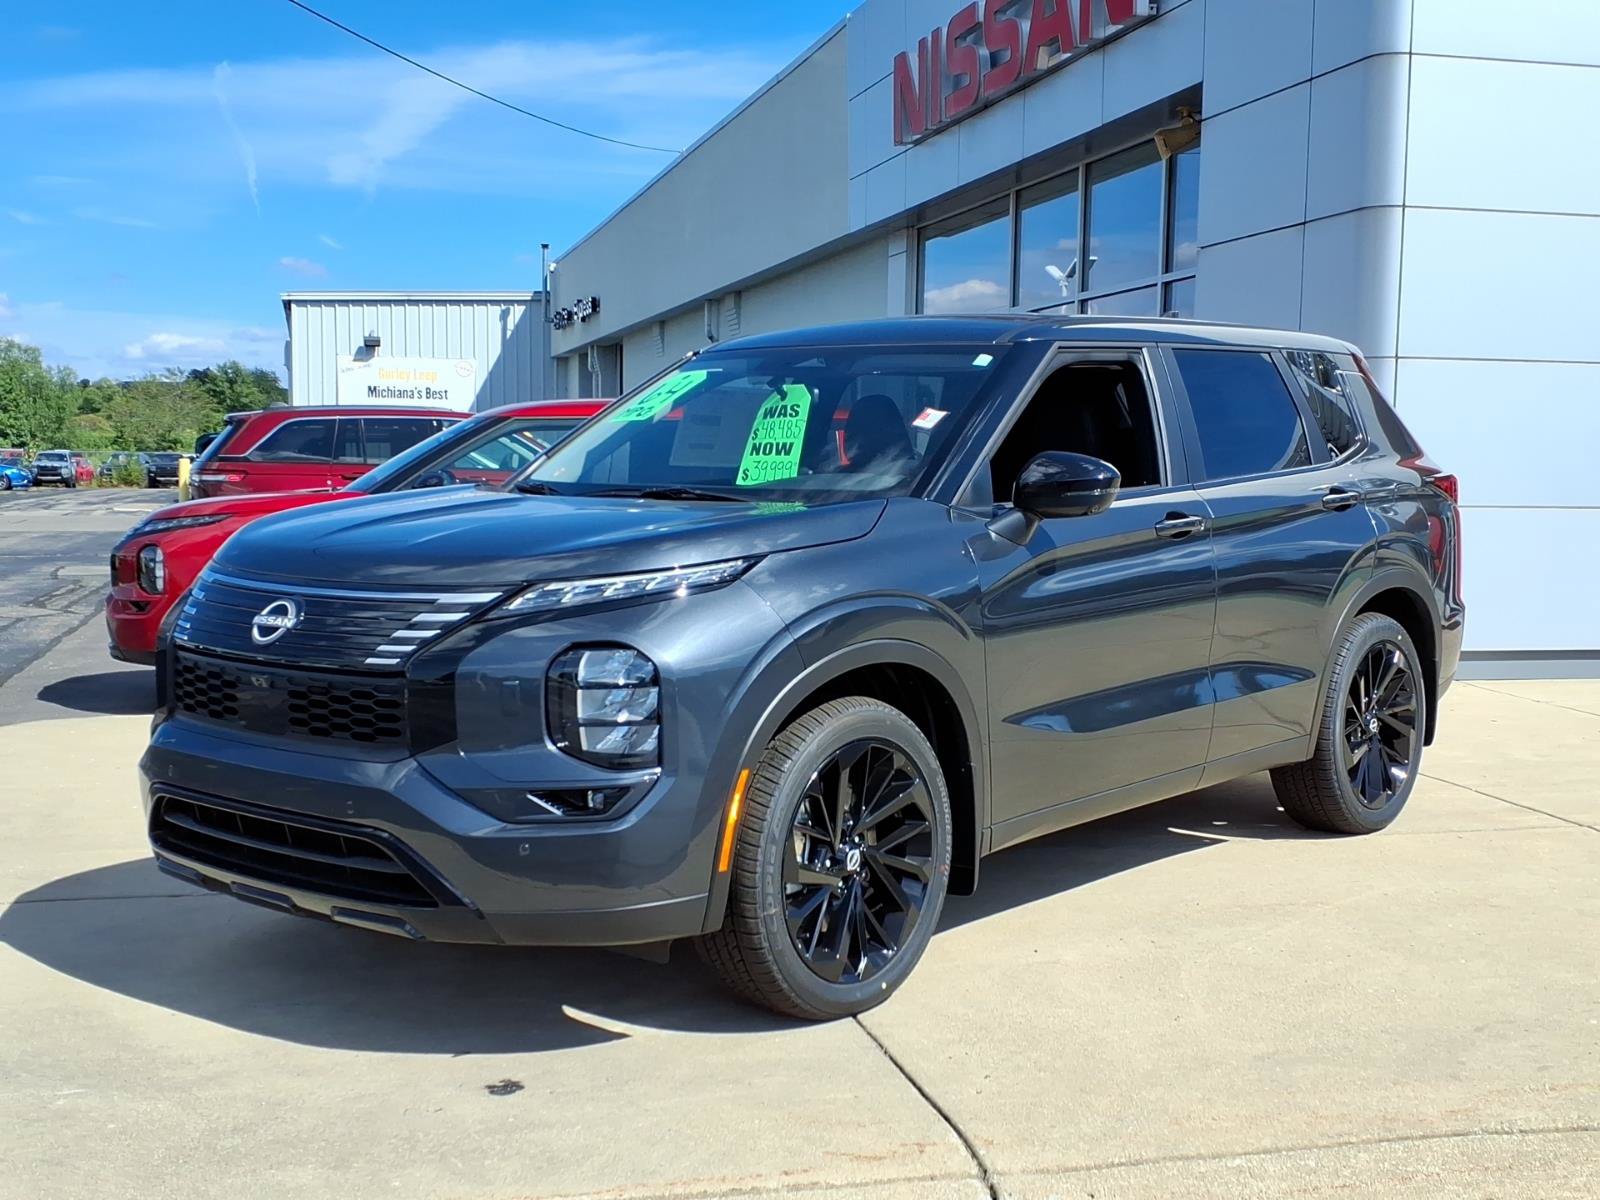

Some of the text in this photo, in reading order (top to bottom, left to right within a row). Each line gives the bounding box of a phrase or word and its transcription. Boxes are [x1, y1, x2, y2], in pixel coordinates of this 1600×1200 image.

[367, 385, 449, 400] Michiana's Best
[762, 403, 800, 419] WAS
[749, 442, 794, 456] NOW
